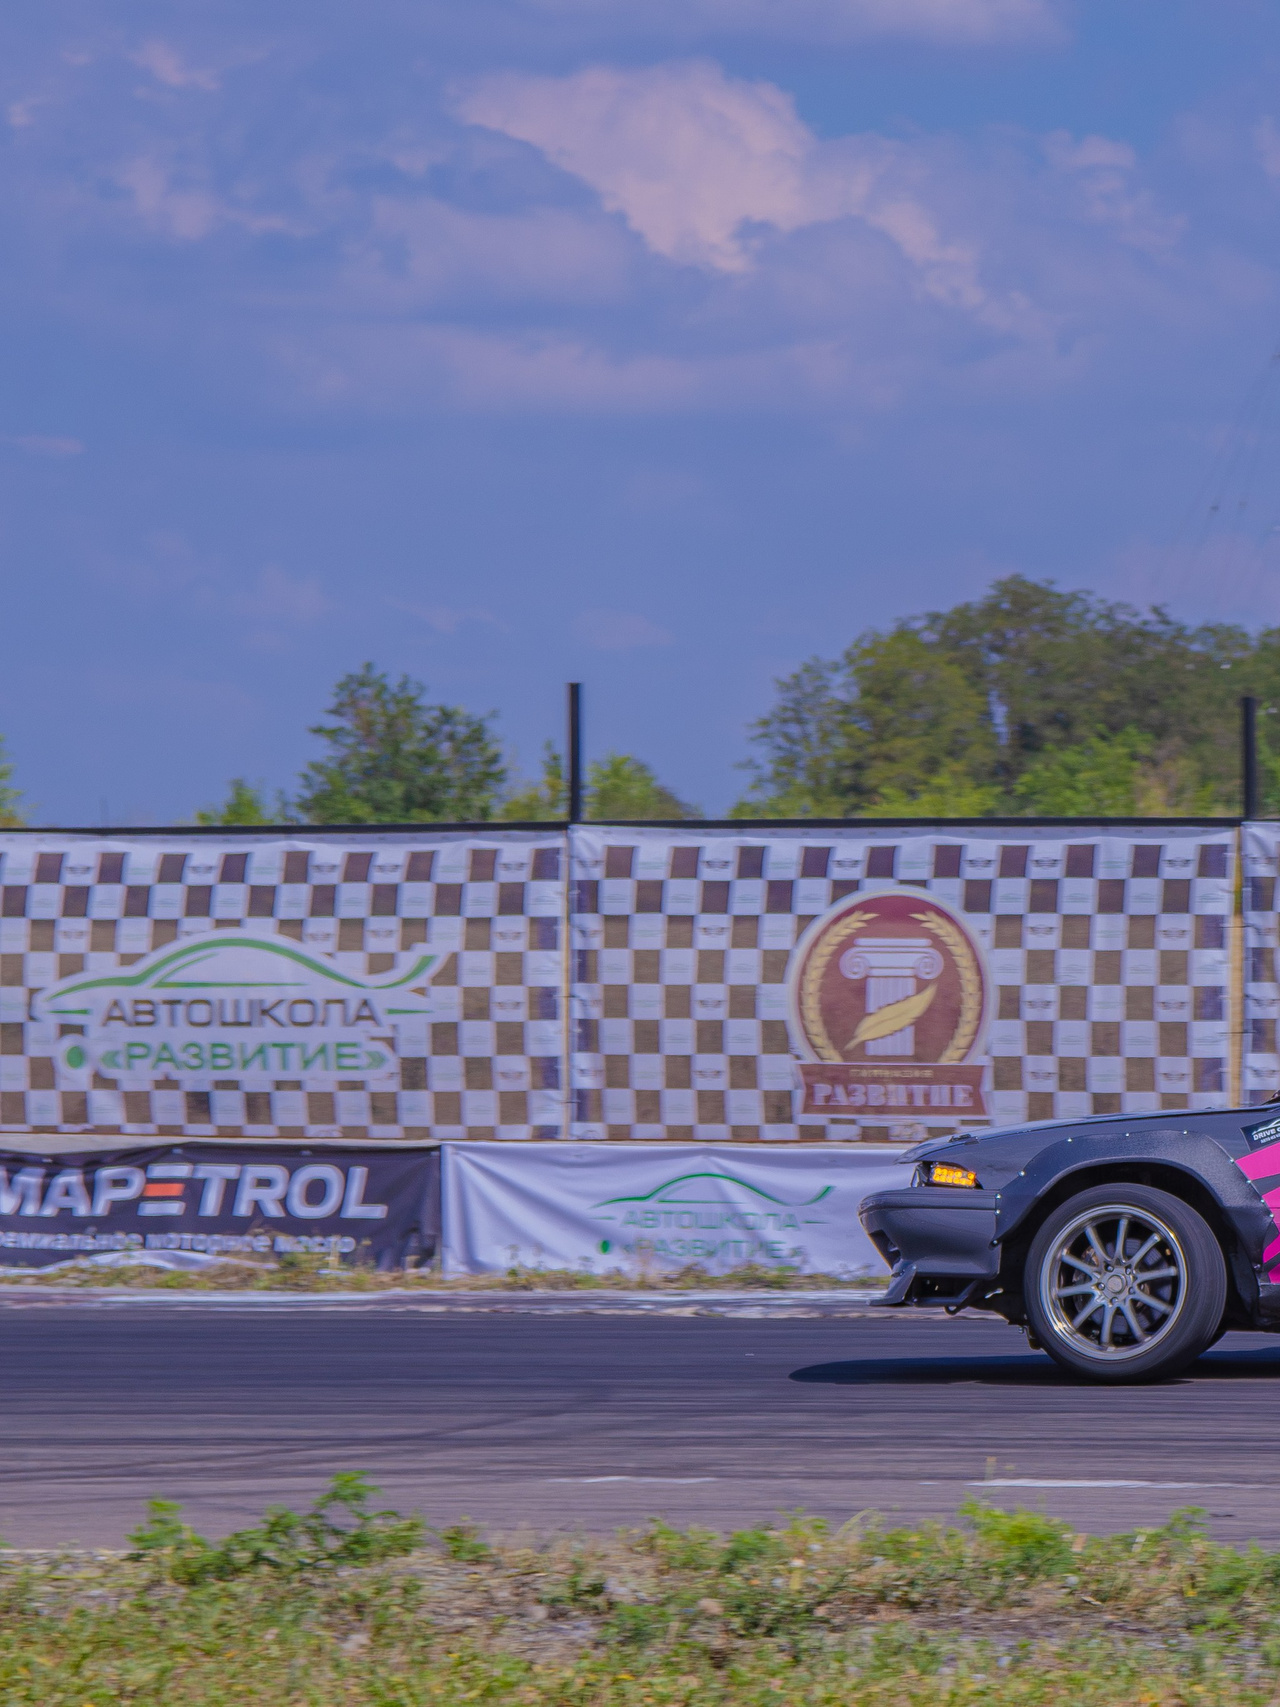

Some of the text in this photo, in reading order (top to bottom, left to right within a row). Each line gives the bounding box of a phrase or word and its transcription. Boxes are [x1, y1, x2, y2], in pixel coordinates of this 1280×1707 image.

[101, 999, 383, 1027] АВТОШКОЛА
[100, 1041, 389, 1071] «РАЗВИТИЕ»
[811, 1083, 974, 1107] РАЗВИТИЕ
[1253, 1128, 1277, 1141] DRIVE
